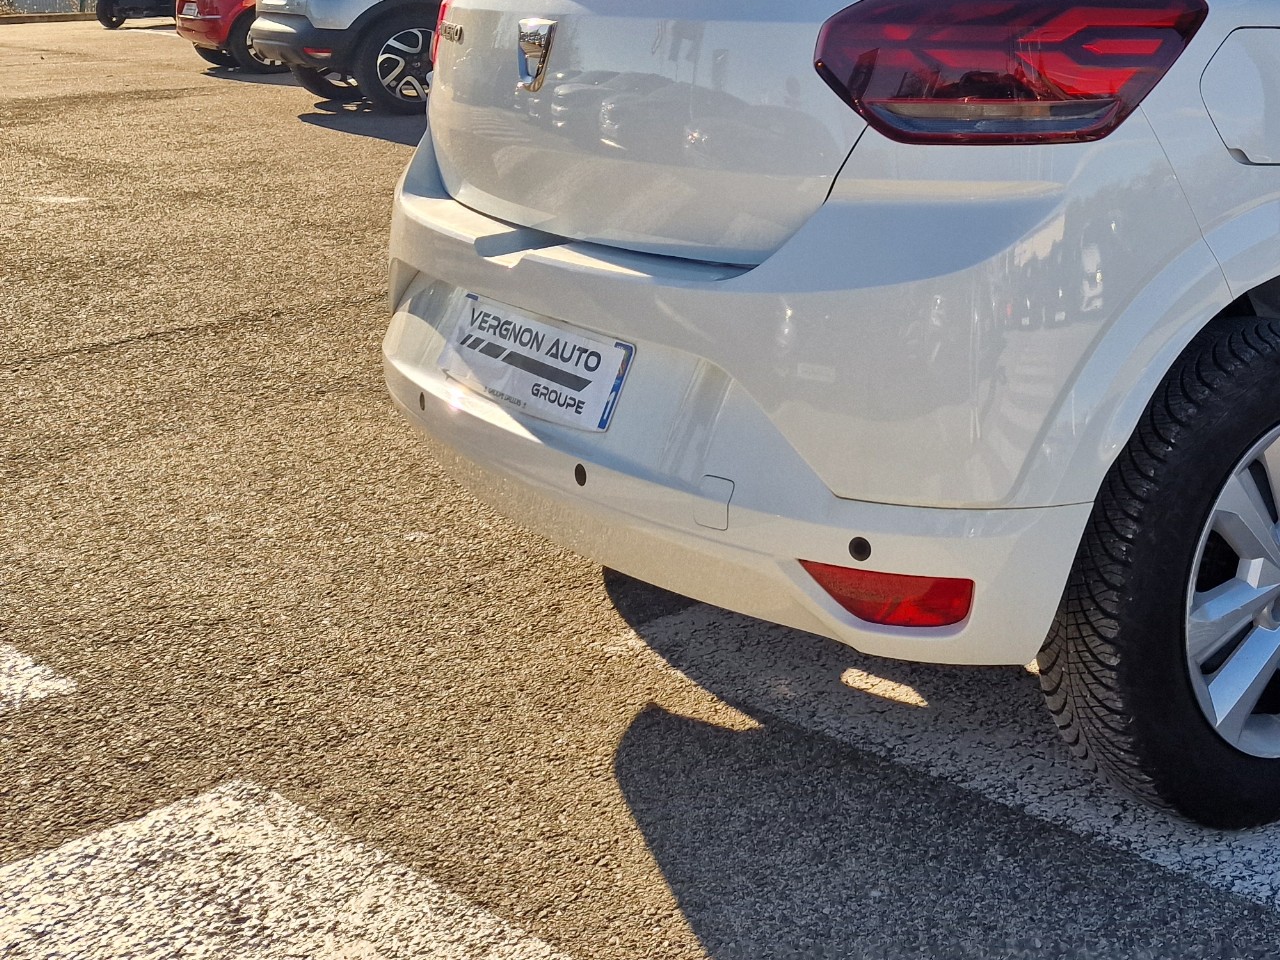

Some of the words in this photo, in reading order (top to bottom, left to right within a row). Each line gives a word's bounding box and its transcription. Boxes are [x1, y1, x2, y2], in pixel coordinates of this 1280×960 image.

[470, 307, 545, 352] VERGNON
[545, 338, 602, 372] AUTO
[531, 382, 586, 415] GROUPE
